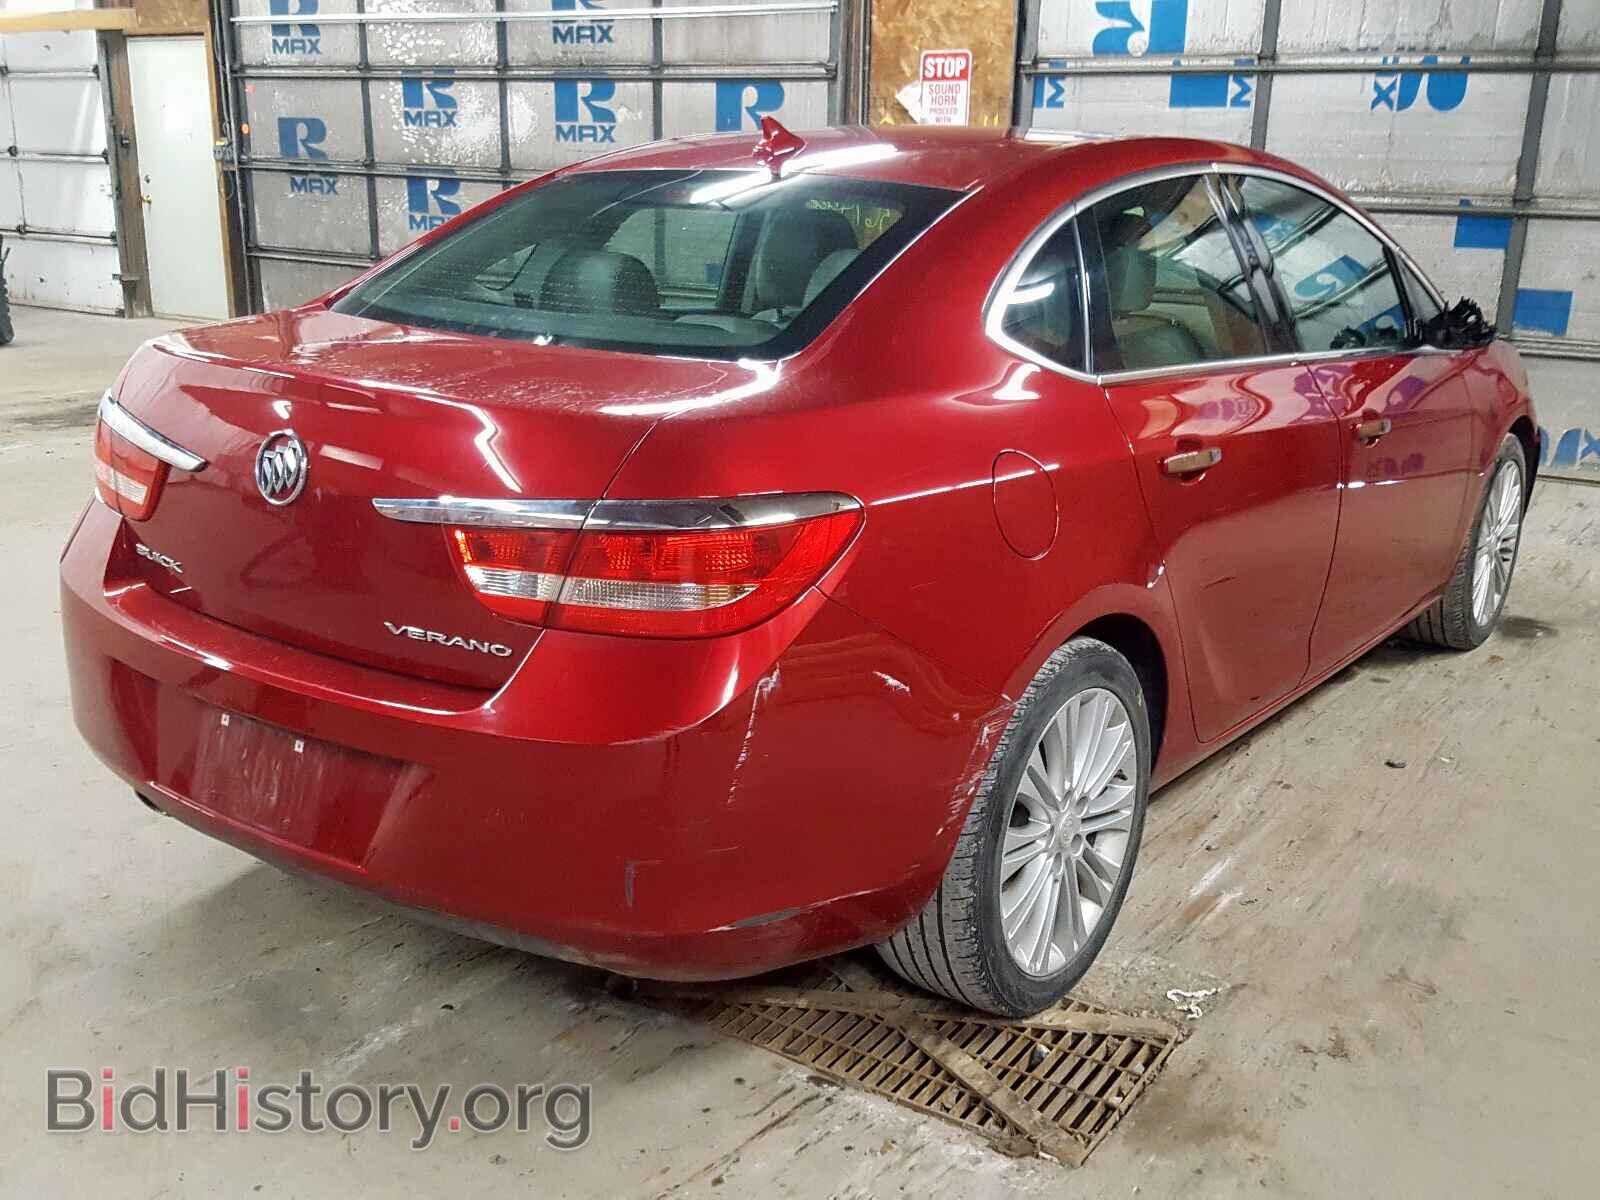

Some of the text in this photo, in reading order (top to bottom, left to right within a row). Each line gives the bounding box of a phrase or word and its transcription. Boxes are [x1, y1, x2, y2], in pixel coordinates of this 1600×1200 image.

[552, 24, 614, 44] MAX
[272, 38, 321, 55] MAX
[924, 56, 967, 78] STOP
[554, 74, 616, 122] R
[928, 83, 961, 95] SOUND
[931, 95, 957, 106] HORN
[403, 110, 458, 128] MAX
[277, 116, 329, 160] R
[555, 124, 617, 143] MAX
[290, 176, 339, 195] MAX
[407, 171, 463, 213] R
[409, 215, 449, 231] MA
[135, 543, 183, 573] BUICK
[383, 620, 513, 657] VERANO
